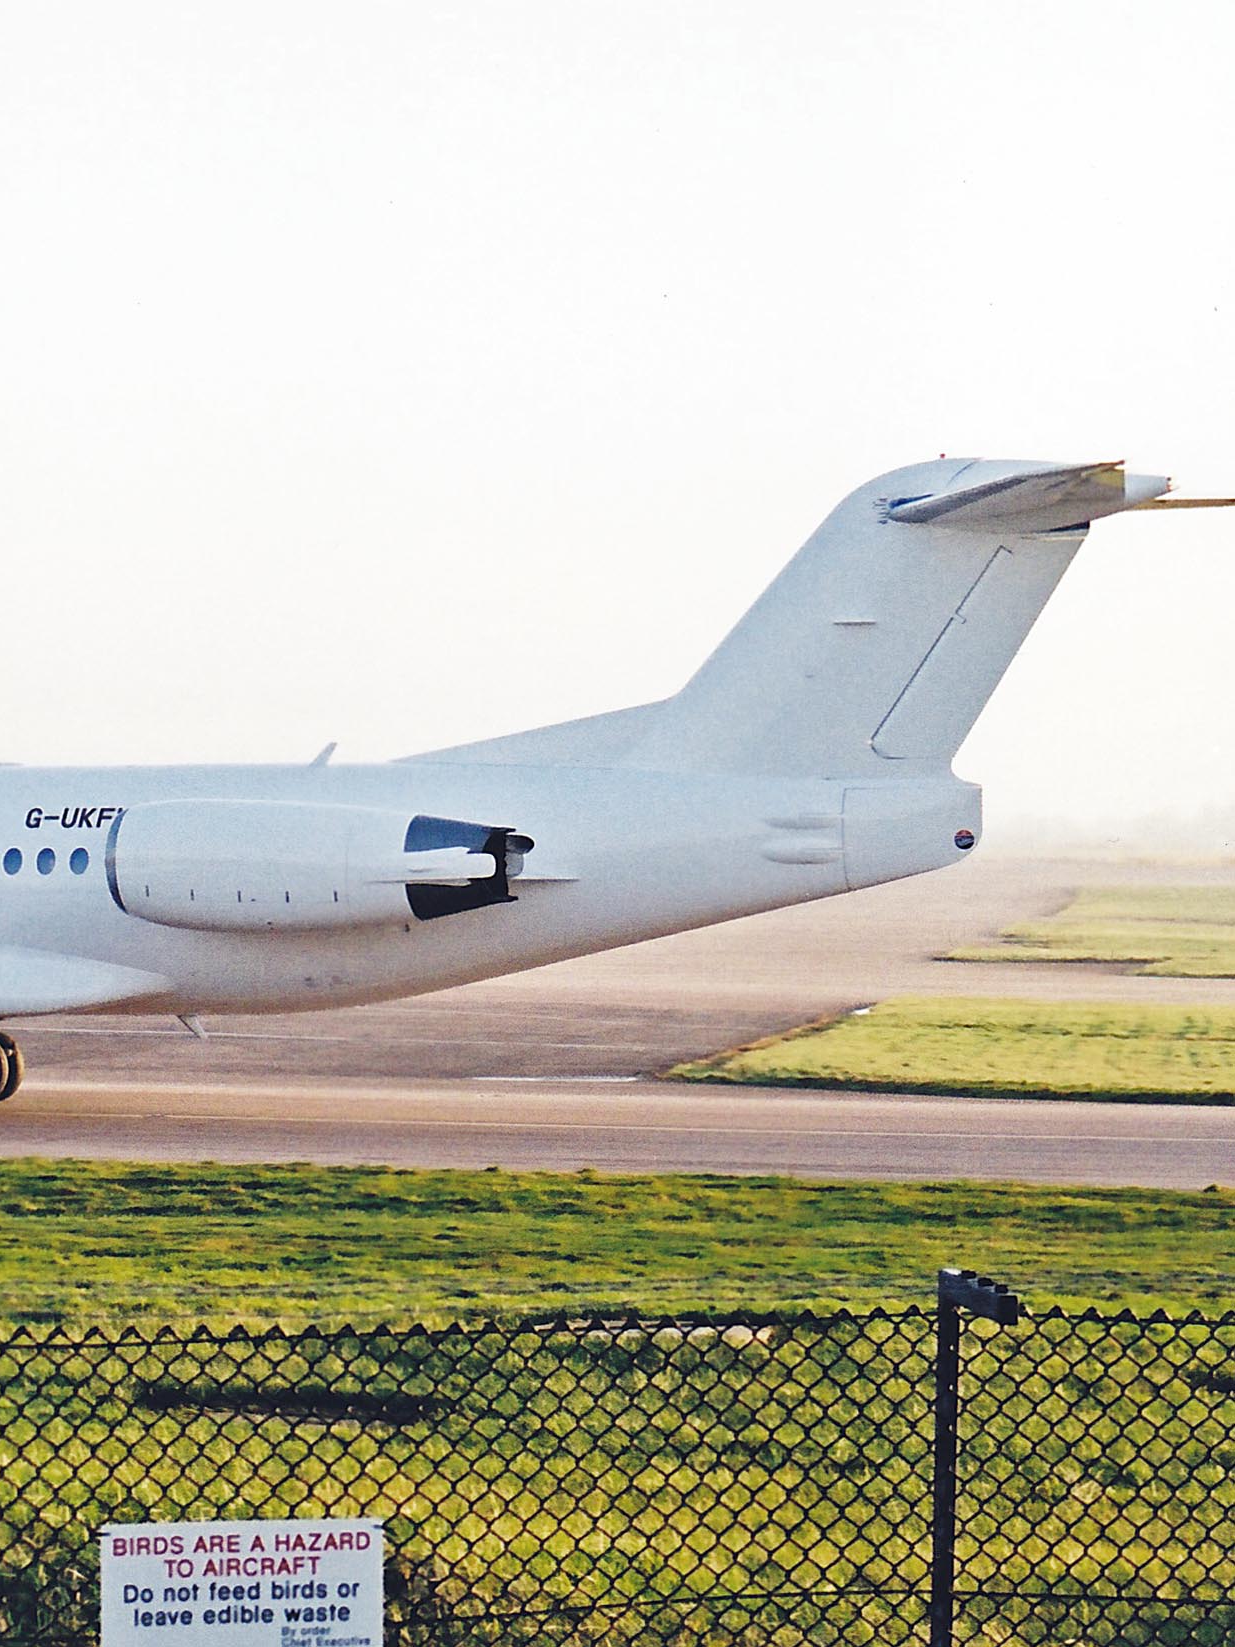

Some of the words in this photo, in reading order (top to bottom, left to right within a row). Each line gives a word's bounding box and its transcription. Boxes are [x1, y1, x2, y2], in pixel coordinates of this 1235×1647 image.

[25, 807, 124, 828] G-UKF
[112, 1536, 184, 1556] BIRDS
[193, 1535, 241, 1553] ARE
[250, 1535, 265, 1552] A
[274, 1532, 371, 1552] HAZARD
[164, 1559, 194, 1578] TO
[203, 1556, 321, 1577] AIRCRAFT
[123, 1584, 153, 1604] Do
[164, 1583, 199, 1602] not
[209, 1582, 261, 1601] feed
[271, 1580, 328, 1600] birds
[337, 1581, 360, 1598] or
[134, 1608, 193, 1627] leave
[203, 1605, 274, 1625] edible
[284, 1604, 351, 1623] waste
[281, 1626, 296, 1637] By
[301, 1625, 331, 1636] order
[281, 1636, 312, 1647] Chief
[316, 1635, 371, 1647] Executive
